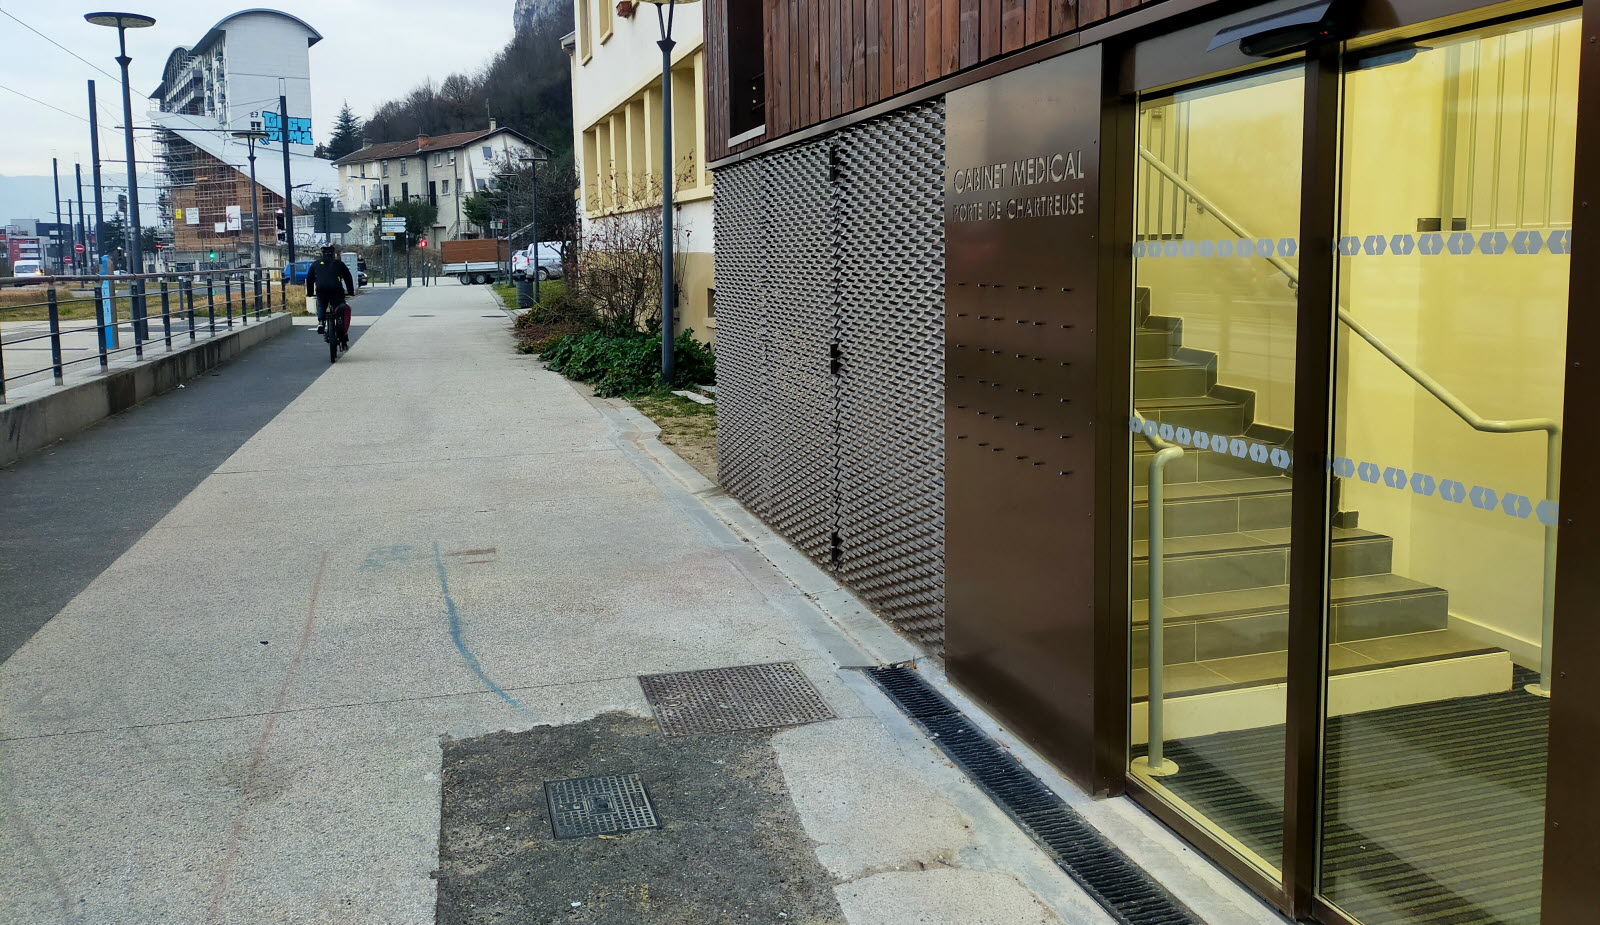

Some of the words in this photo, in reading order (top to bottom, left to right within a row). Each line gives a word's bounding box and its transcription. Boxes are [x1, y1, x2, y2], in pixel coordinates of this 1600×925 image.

[953, 163, 1007, 194] CABINET
[1011, 150, 1085, 187] MEDICAL
[952, 202, 983, 223] PORTE
[987, 201, 1001, 220] DE
[1006, 192, 1084, 220] CHARTREUSE
